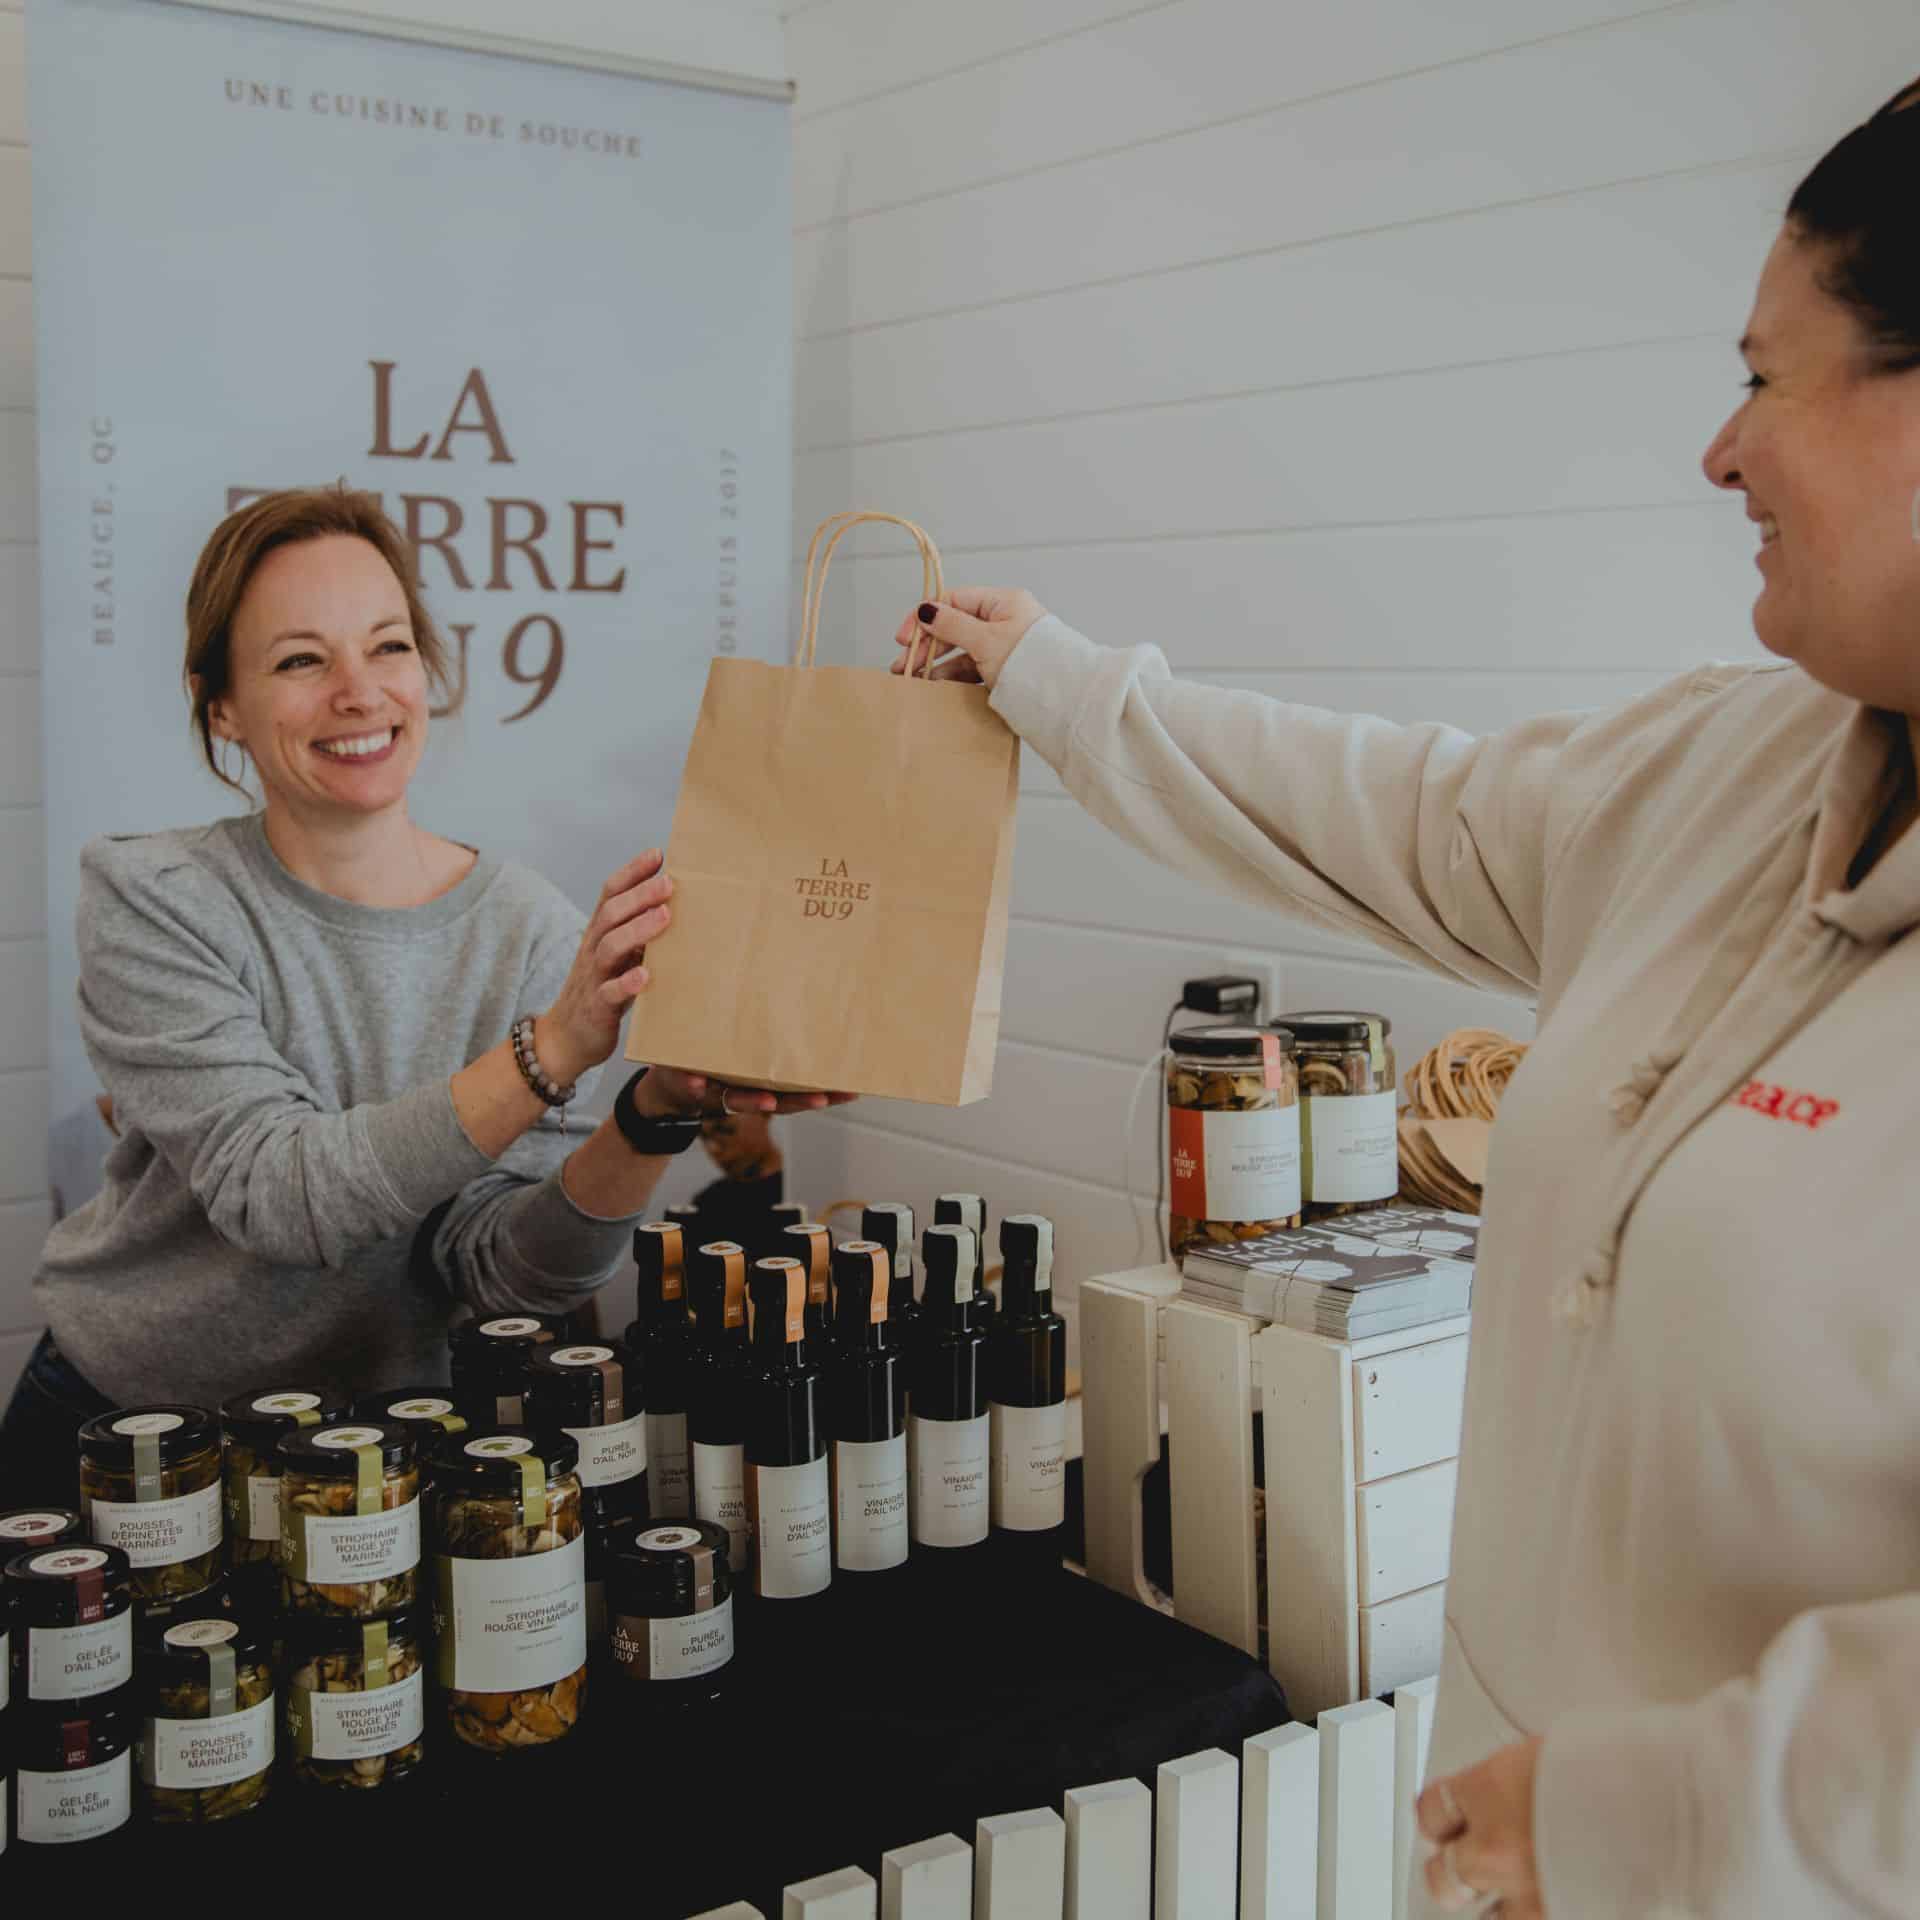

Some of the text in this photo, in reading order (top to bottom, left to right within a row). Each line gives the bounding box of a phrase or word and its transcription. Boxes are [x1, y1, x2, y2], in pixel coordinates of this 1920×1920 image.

[224, 78, 642, 159] UNE CUISINE DE SOUCHE
[367, 360, 515, 463] LA
[92, 416, 116, 464] QC
[228, 487, 627, 593] RRE
[718, 449, 736, 652] DEPUIS 2017
[820, 857, 848, 878] LA
[795, 877, 871, 901] TERRE
[378, 1537, 396, 1550] VIN
[526, 1616, 544, 1629] VIN
[384, 1710, 401, 1722] VIN
